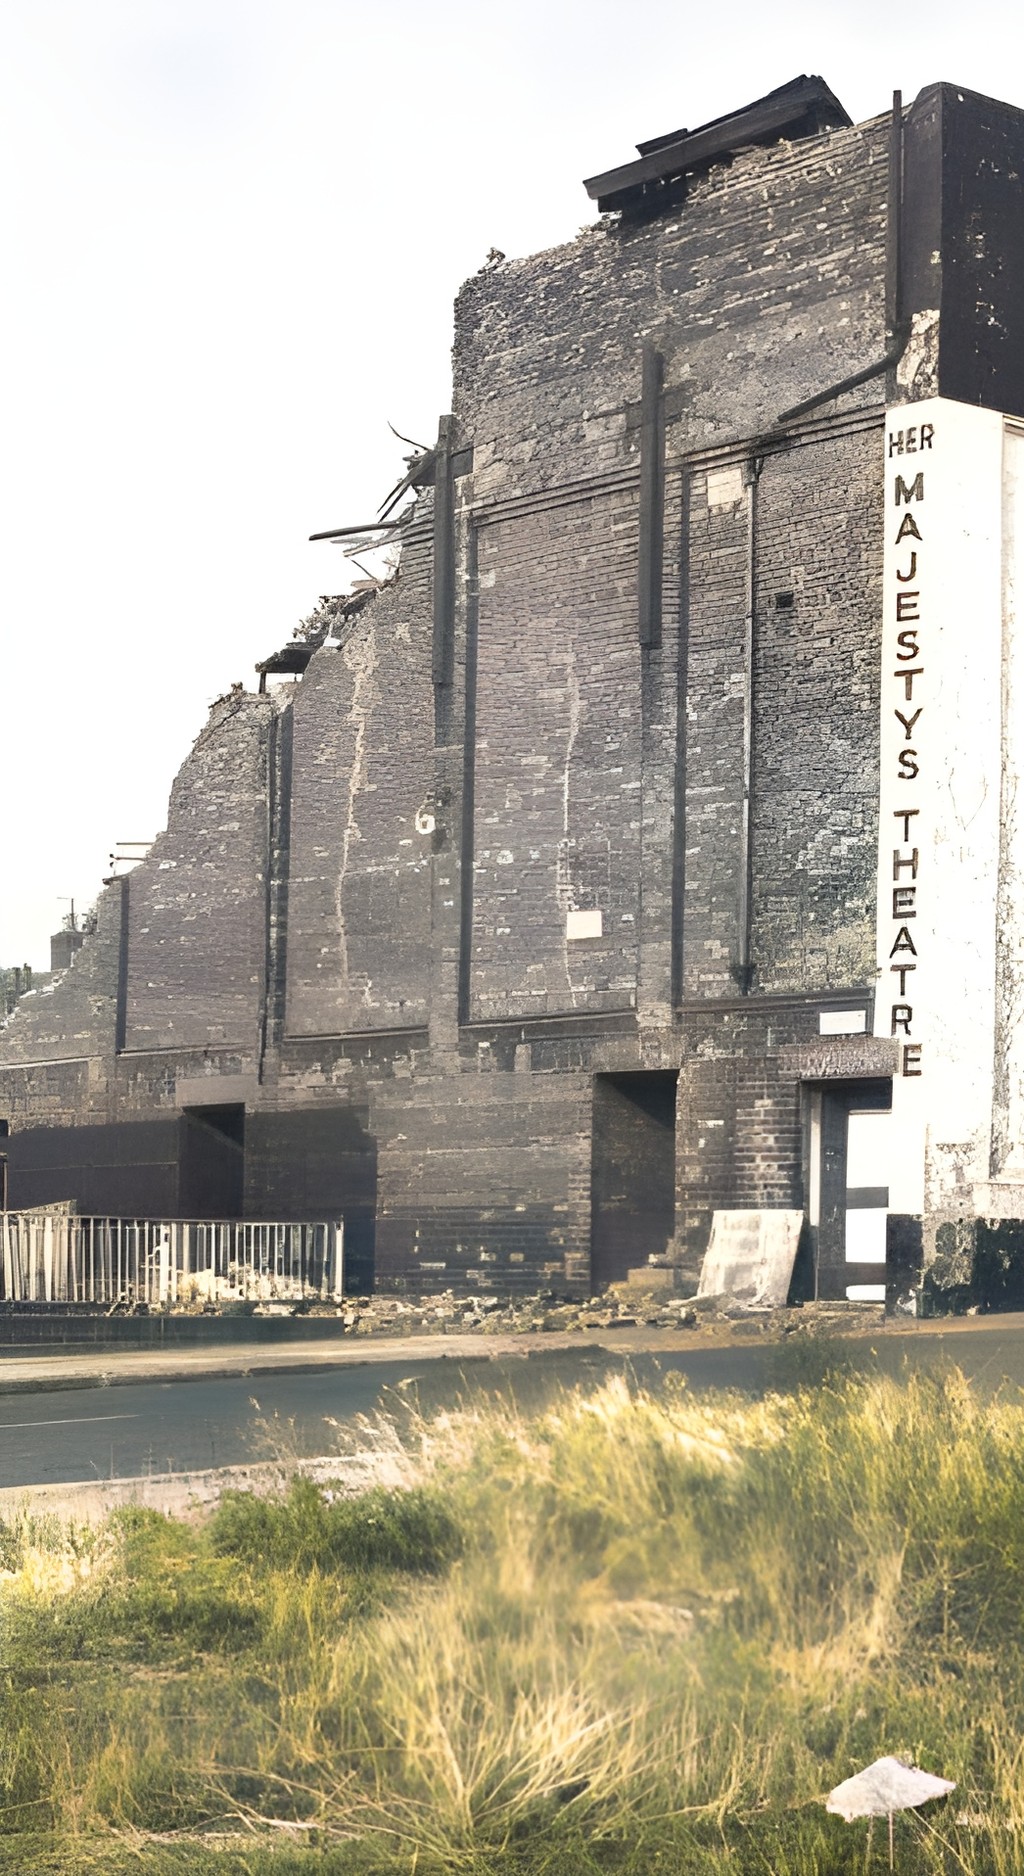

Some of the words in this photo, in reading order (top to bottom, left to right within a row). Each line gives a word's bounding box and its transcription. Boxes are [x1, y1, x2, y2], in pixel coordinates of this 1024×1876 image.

[888, 423, 935, 458] HER
[893, 472, 925, 780] MAJESTYS
[889, 809, 923, 1077] THEATRE
